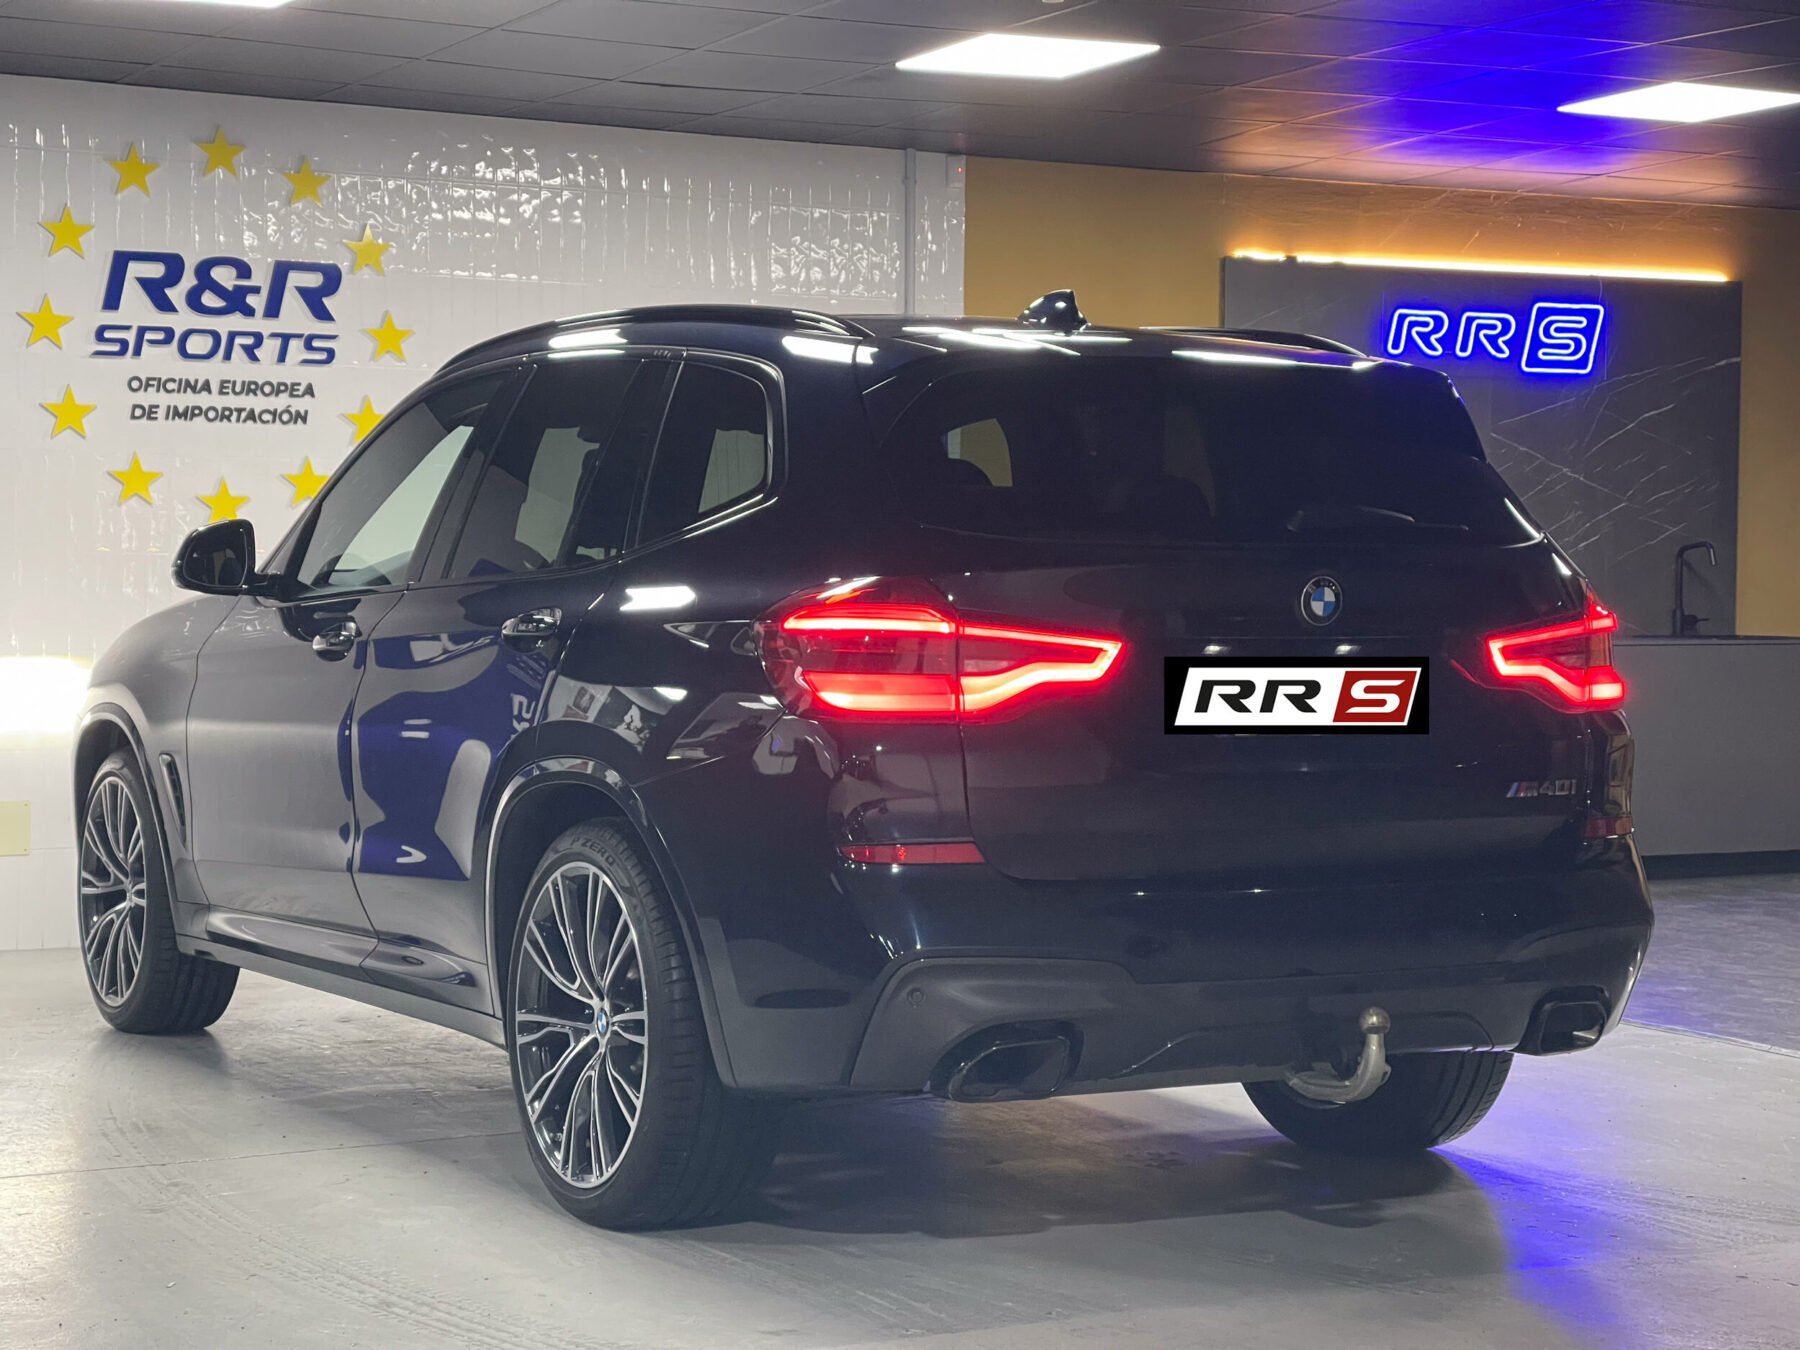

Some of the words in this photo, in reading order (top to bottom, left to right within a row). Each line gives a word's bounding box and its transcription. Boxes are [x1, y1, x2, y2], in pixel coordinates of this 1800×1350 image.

[102, 250, 343, 322] R&R
[91, 324, 339, 365] SPORTS
[128, 376, 212, 395] OFICINA
[218, 379, 316, 399] EUROPEA
[130, 404, 159, 421] DE
[165, 404, 308, 426] IMPORTACIÓN
[581, 838, 616, 867] ZERO
